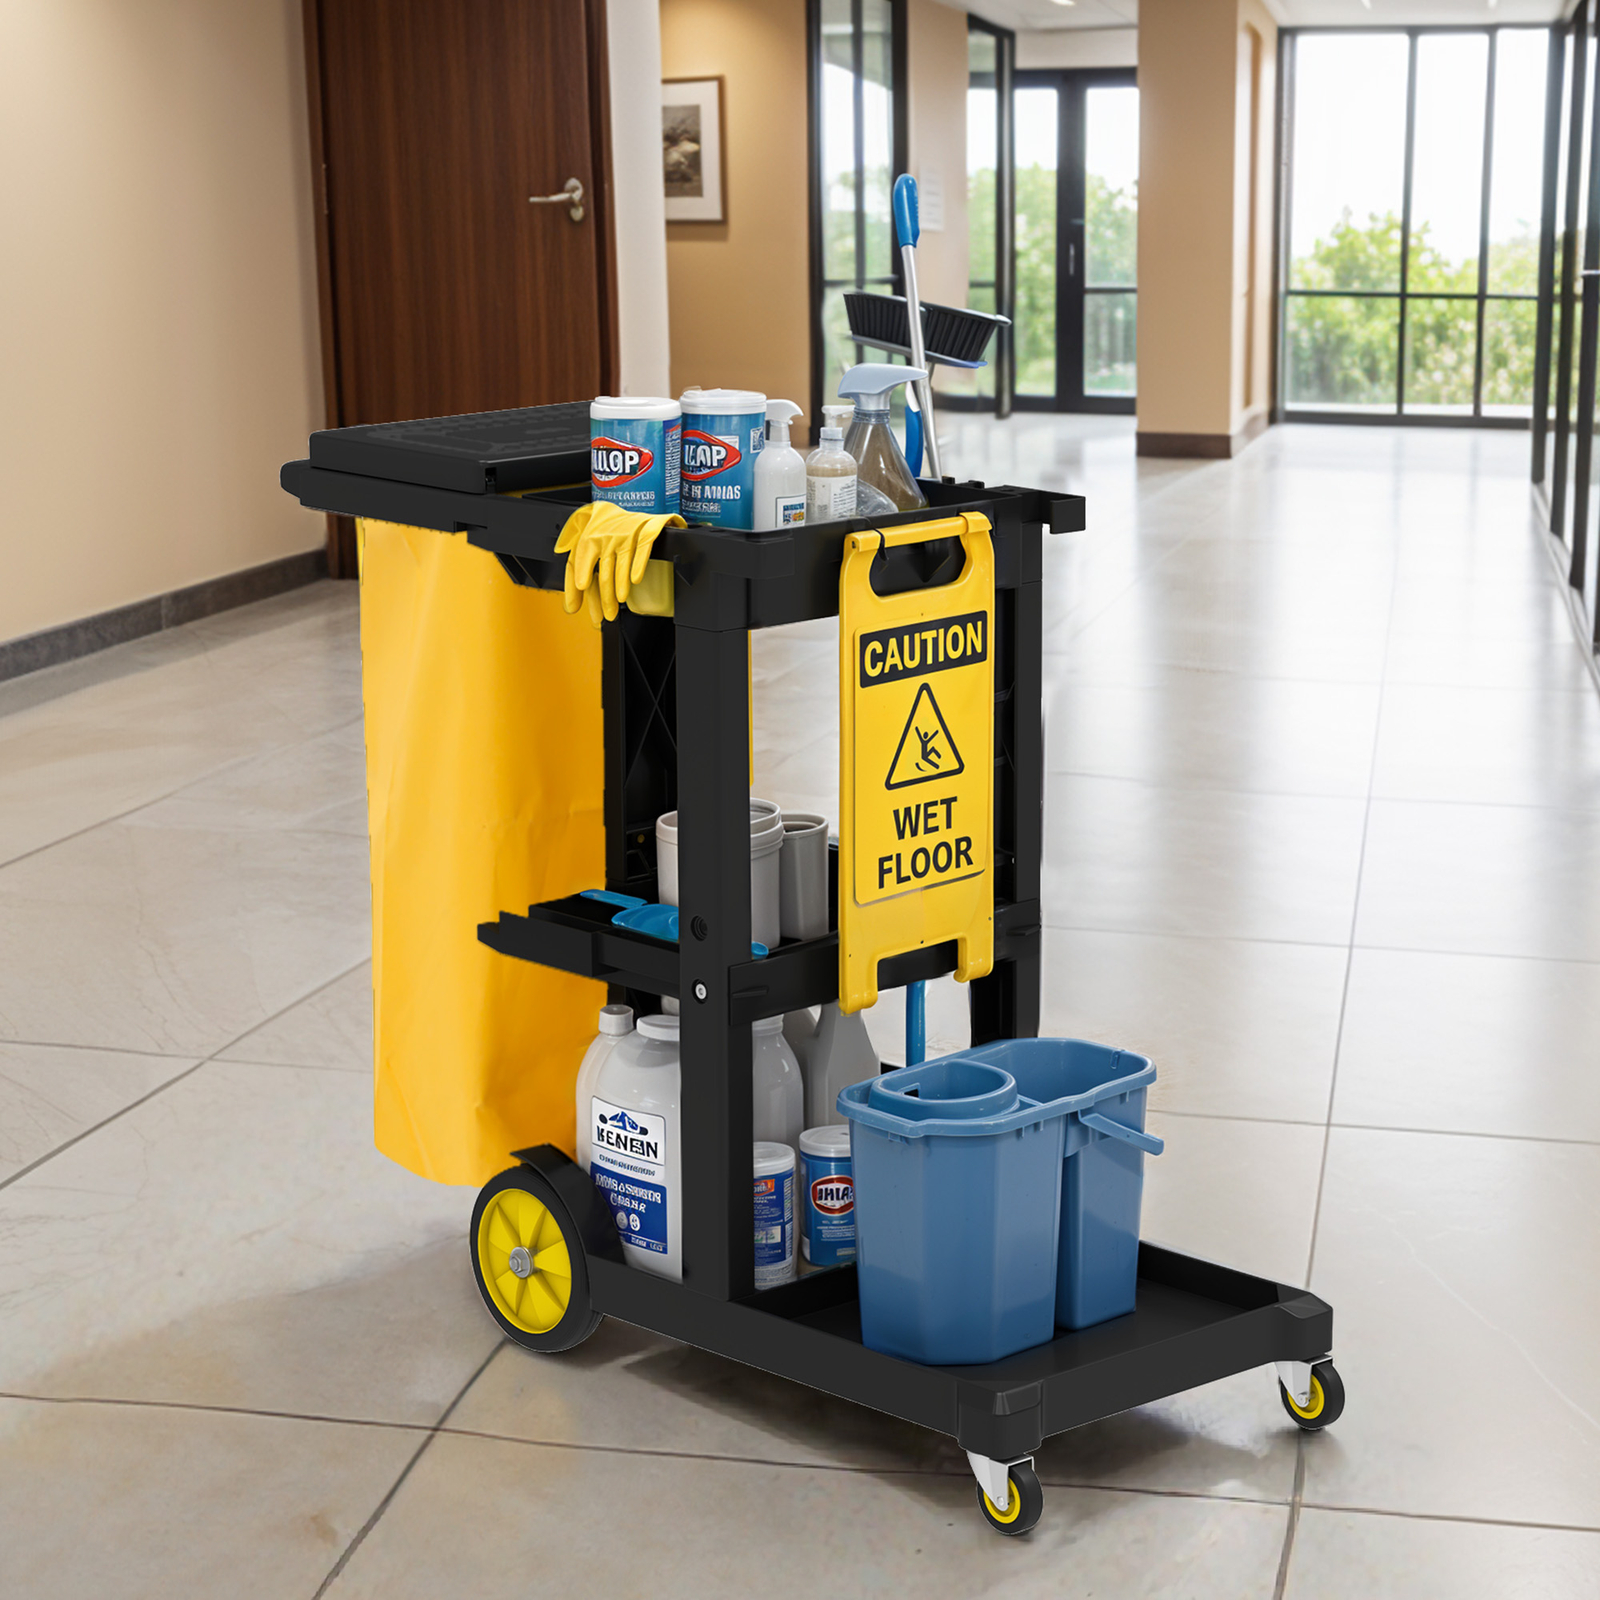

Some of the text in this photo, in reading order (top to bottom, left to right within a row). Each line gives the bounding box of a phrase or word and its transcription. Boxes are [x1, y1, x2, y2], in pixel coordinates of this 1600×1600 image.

[864, 620, 983, 678] CAUTION
[892, 796, 958, 841] WET
[878, 835, 974, 890] FLOOR
